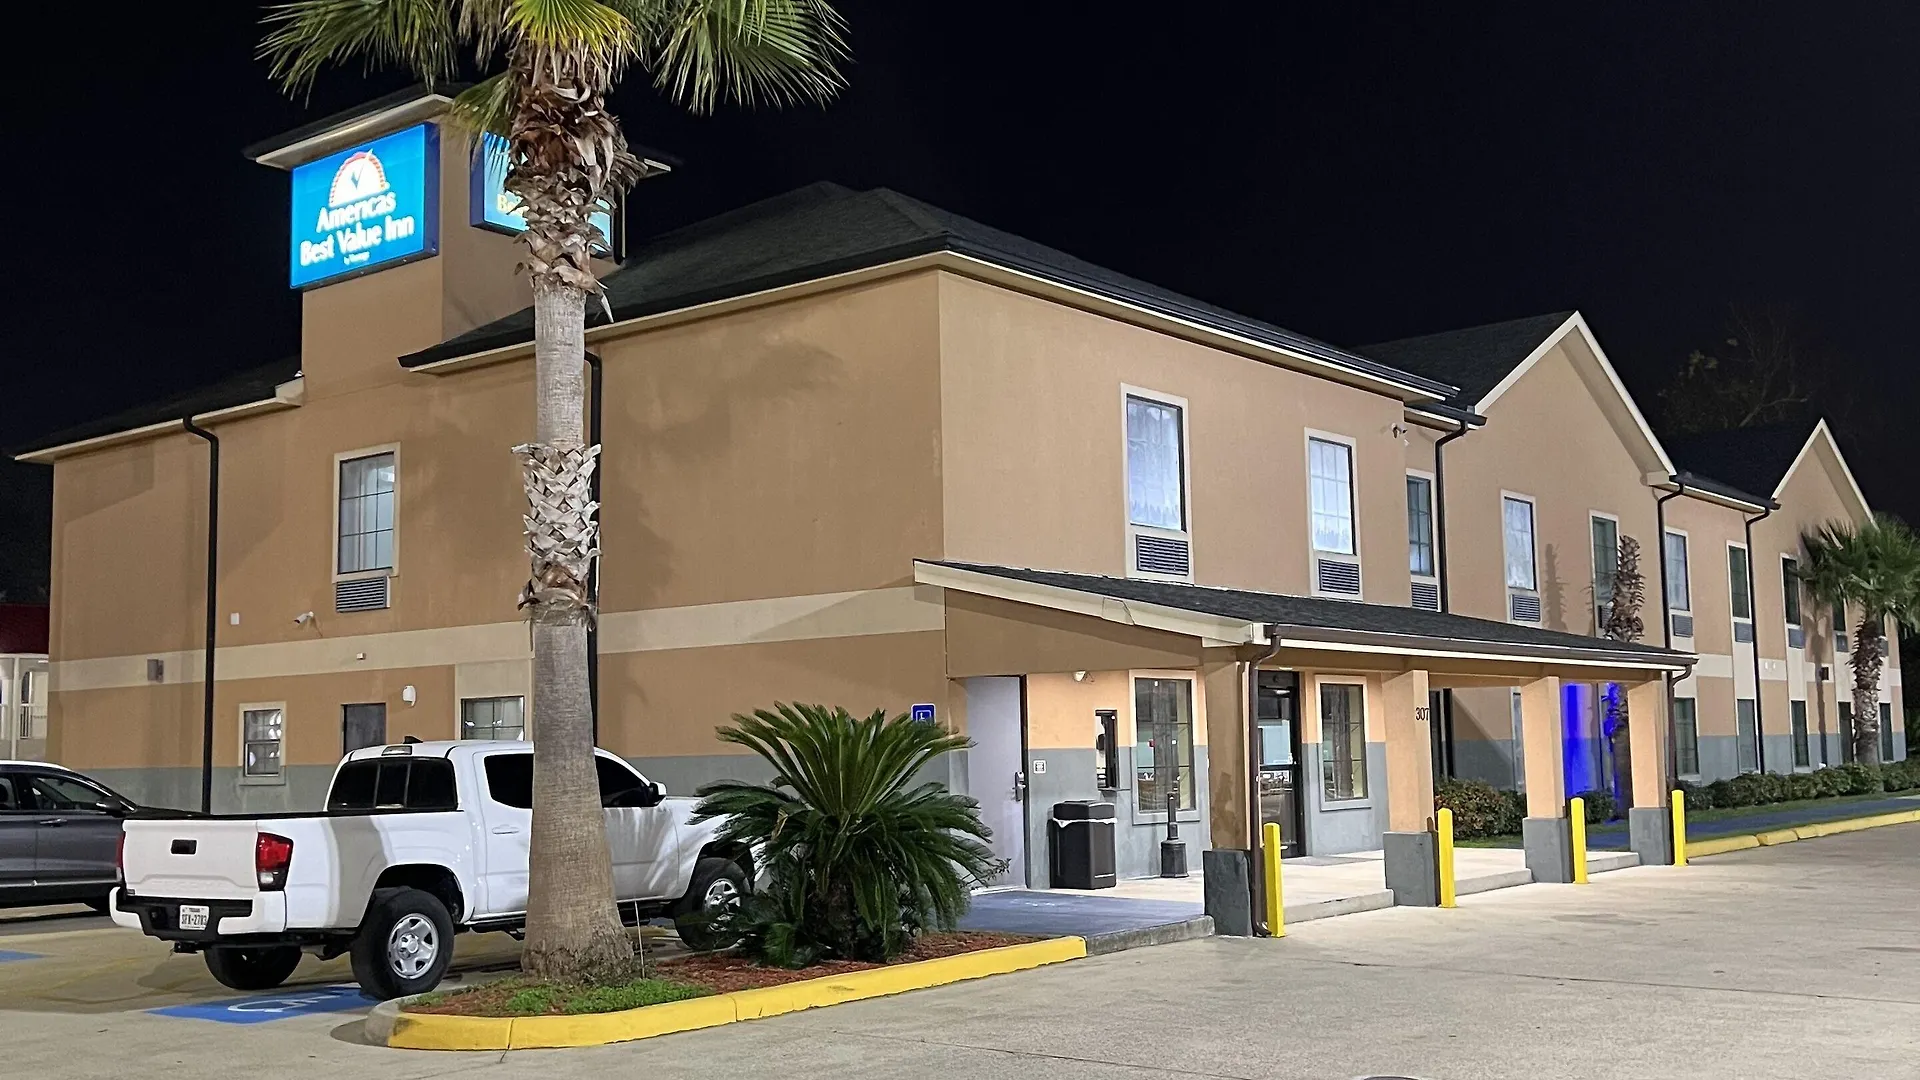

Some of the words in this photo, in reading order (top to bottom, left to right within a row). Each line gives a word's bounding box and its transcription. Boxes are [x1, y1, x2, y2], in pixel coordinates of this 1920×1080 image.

[316, 192, 396, 233] Americas
[300, 234, 334, 266] Best
[337, 222, 383, 254] Value
[385, 215, 415, 242] Inn
[1415, 706, 1430, 721] 307
